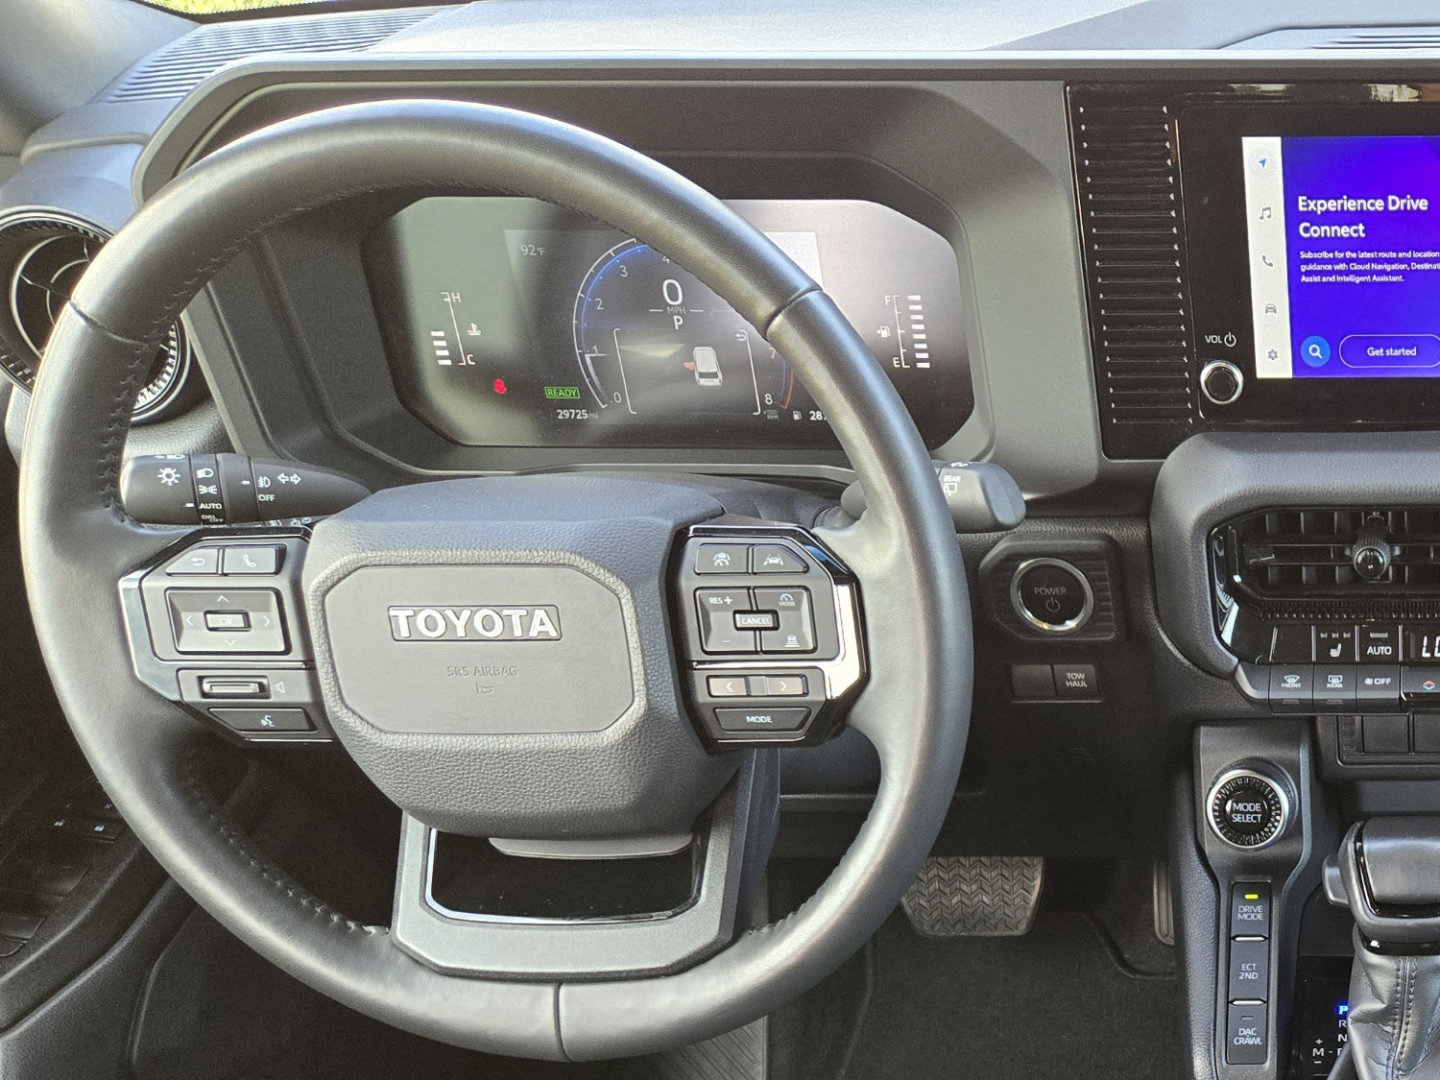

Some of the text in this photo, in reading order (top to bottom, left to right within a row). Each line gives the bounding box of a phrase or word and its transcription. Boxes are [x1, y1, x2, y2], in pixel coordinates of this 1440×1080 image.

[1298, 194, 1428, 214] Experience Drive
[1299, 222, 1366, 238] Connect
[1300, 250, 1334, 259] Subscribe
[1334, 250, 1345, 258] for
[1345, 250, 1357, 258] the
[1358, 250, 1378, 258] latest
[1398, 250, 1412, 258] and
[1412, 250, 1440, 258] location
[619, 265, 629, 278] 3
[1300, 262, 1332, 272] guidance
[1333, 262, 1348, 270] with
[1349, 262, 1370, 270] Cloud
[1371, 262, 1410, 272] Navigation,
[1301, 274, 1321, 282] Assist
[1336, 274, 1371, 284] Intelligent
[1371, 274, 1405, 282] Assistant.
[662, 278, 684, 305] 0
[451, 292, 462, 303] H
[885, 296, 891, 304] F
[595, 298, 604, 310] 2
[666, 307, 687, 315] MPH
[674, 315, 684, 330] P
[1205, 335, 1222, 344] VOL
[1367, 346, 1416, 356] Get started
[466, 354, 475, 365] C
[893, 357, 901, 367] E
[547, 388, 577, 397] READY
[613, 392, 622, 403] 0
[764, 393, 774, 405] 8
[556, 408, 589, 420] 29725
[809, 410, 827, 421] 28.
[258, 494, 275, 502] OFF
[199, 502, 223, 510] AUTO
[1034, 587, 1067, 596] POWER
[708, 596, 723, 604] RES
[388, 608, 559, 639] TOYOTA
[741, 615, 771, 625] CANCEL
[1366, 645, 1392, 656] AUTO
[447, 665, 518, 677] SRS AIRBAG
[1065, 672, 1085, 680] TOW
[1065, 680, 1088, 688] HAUL
[1374, 677, 1392, 685] OFF
[745, 715, 773, 724] MODE
[1232, 802, 1262, 812] MODE
[1231, 813, 1262, 823] SELECT
[1238, 905, 1264, 913] DRIVE
[1237, 912, 1264, 921] MODE
[1241, 963, 1257, 971] ECT
[1238, 971, 1259, 980] 2ND
[1338, 1005, 1349, 1015] P
[1338, 1019, 1347, 1028] R
[1238, 1027, 1257, 1036] DAC
[1233, 1036, 1263, 1046] CRAWL
[1337, 1033, 1348, 1042] N
[1312, 1047, 1324, 1057] M
